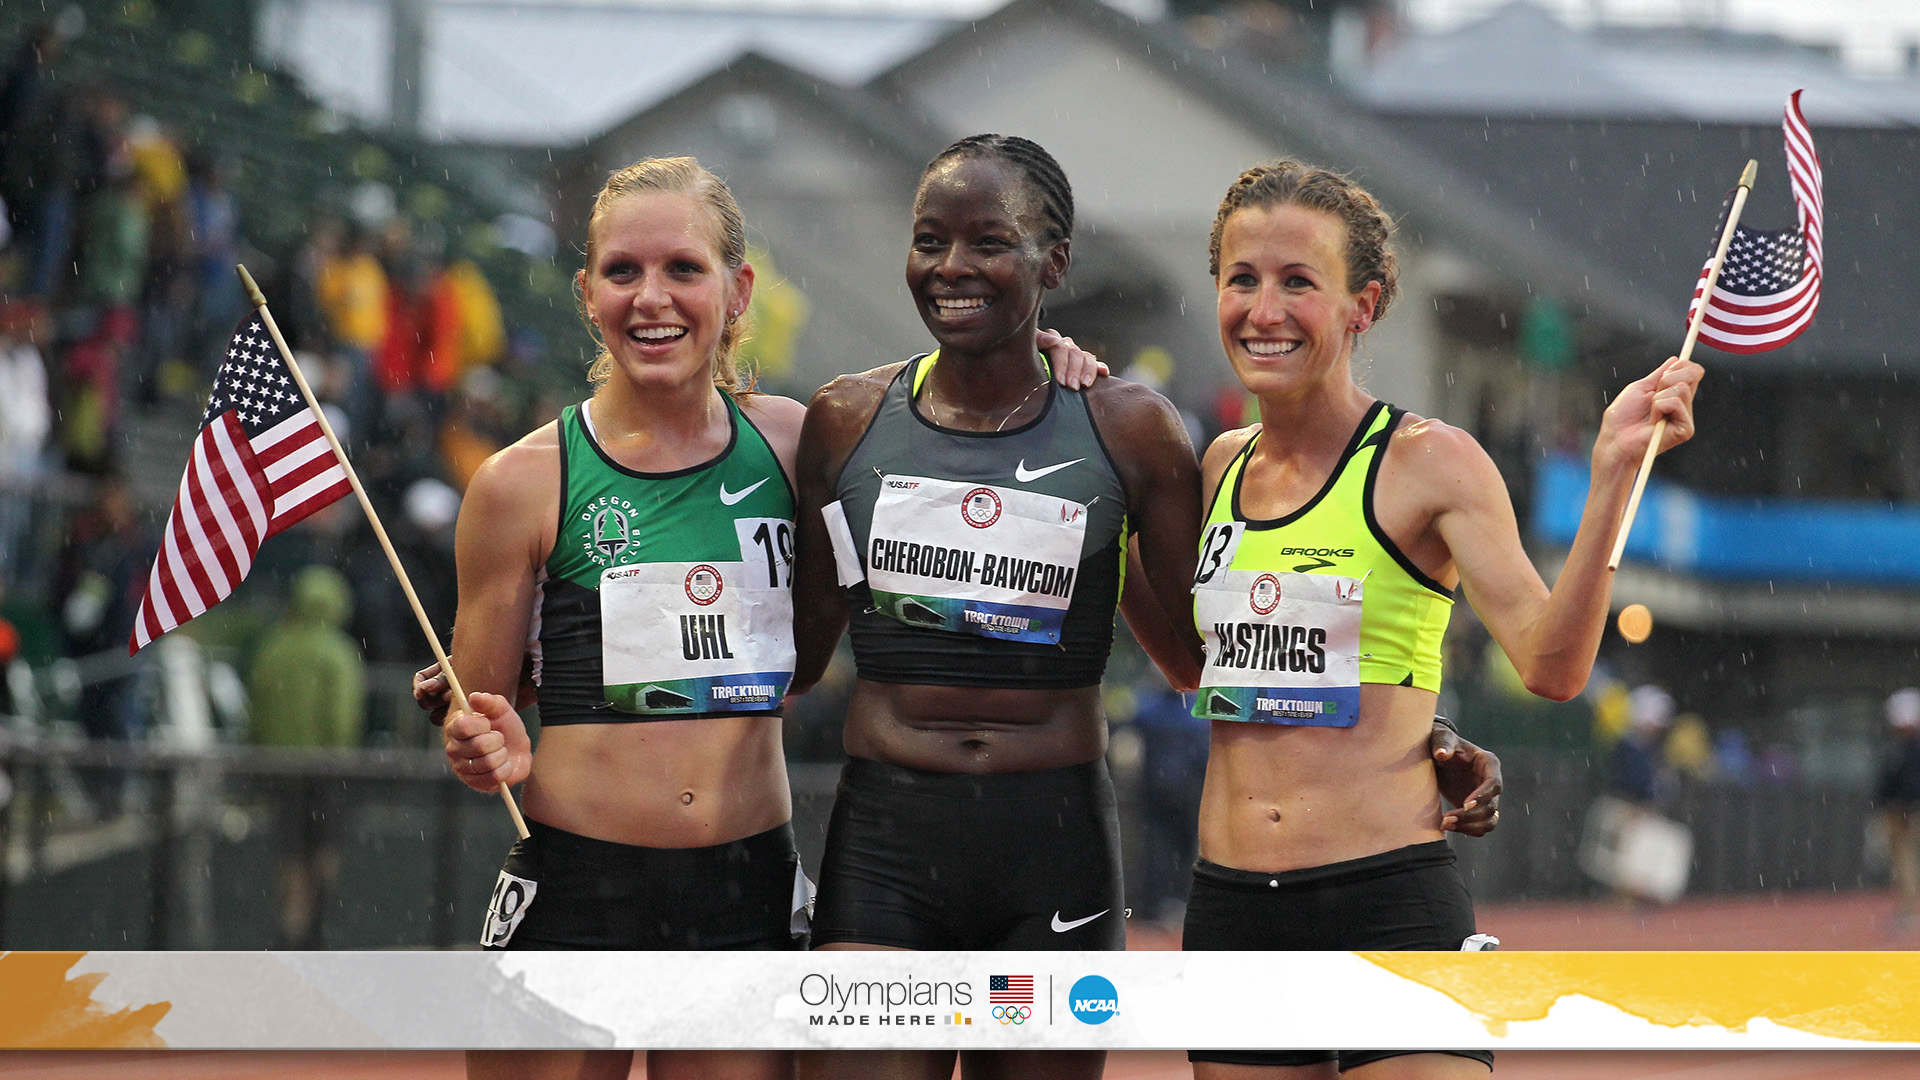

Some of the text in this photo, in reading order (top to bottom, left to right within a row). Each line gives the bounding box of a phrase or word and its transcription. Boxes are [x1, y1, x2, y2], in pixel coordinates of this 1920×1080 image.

[582, 496, 639, 521] OREGON
[582, 529, 640, 566] TRACK CLUB
[753, 523, 792, 588] 19
[871, 538, 1074, 598] CHEROBON-BAWCOM
[1194, 525, 1233, 584] 13
[1280, 547, 1355, 558] BROOKS
[680, 614, 734, 660] UHL
[1213, 622, 1326, 674] HASTINGS
[485, 877, 525, 943] 19
